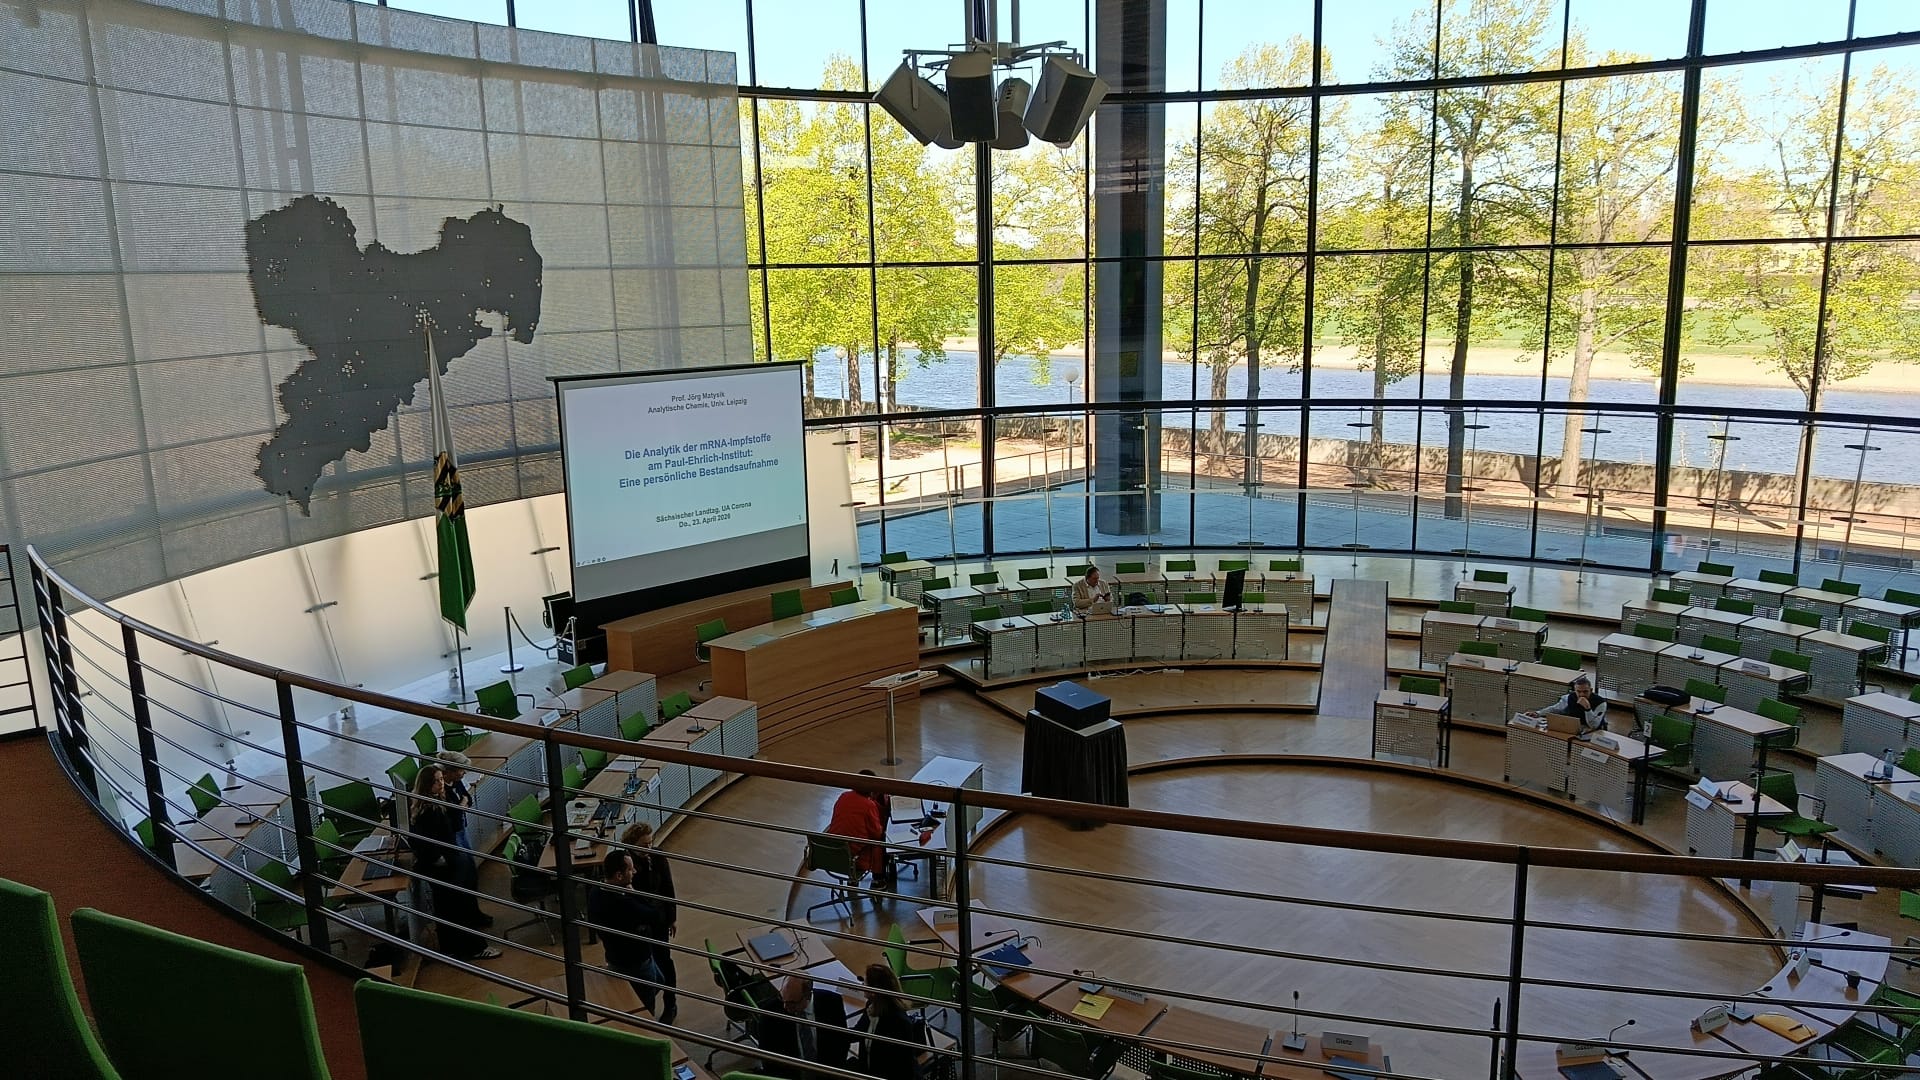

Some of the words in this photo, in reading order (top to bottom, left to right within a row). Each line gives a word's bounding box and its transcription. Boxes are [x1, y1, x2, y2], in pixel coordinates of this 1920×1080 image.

[648, 403, 684, 413] Analytische
[711, 400, 724, 408] Univ.
[726, 398, 748, 406] Leipzig
[687, 393, 701, 401] Jörg
[702, 391, 725, 400] Matysik
[625, 450, 641, 460] Die
[643, 445, 681, 457] Analytik
[683, 443, 698, 453] der
[700, 433, 772, 451] mRNA-Impfstoffe
[648, 462, 663, 471] am
[665, 449, 753, 469] Paul-Ehrlich-Institut:
[619, 477, 641, 489] Eine
[643, 468, 697, 487] persönliche
[699, 457, 779, 477] Bestandsaufnahme
[656, 511, 694, 523] Sächsischer
[721, 504, 731, 512] UA
[731, 501, 752, 510] Corona
[702, 515, 716, 524] April
